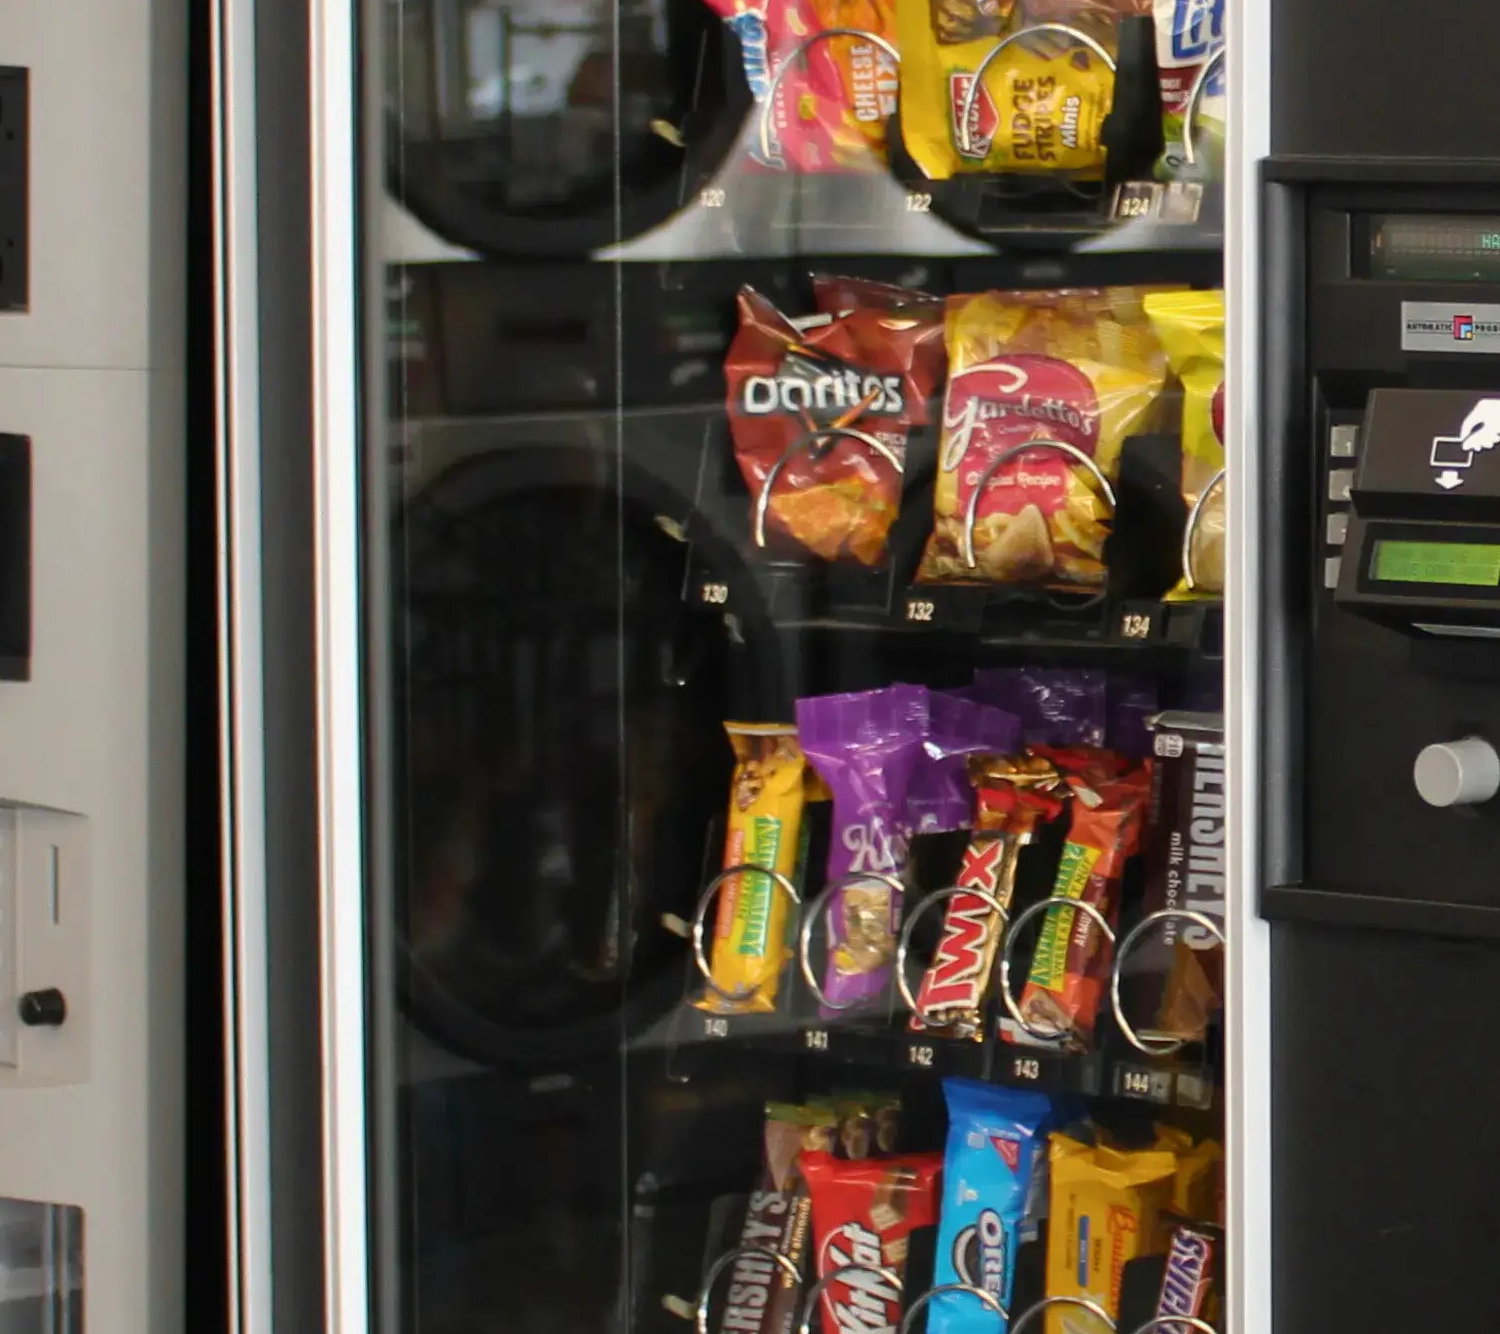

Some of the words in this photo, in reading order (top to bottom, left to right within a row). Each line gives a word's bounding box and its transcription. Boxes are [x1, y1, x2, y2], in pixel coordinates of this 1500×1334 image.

[850, 44, 878, 122] CHEESE
[1013, 78, 1035, 161] FUDGE
[1034, 75, 1056, 164] STRIPES
[1060, 95, 1081, 149] Minis
[906, 194, 932, 214] 122
[1122, 198, 1150, 218] 124
[744, 369, 903, 414] Doritos
[1017, 471, 1062, 489] Recipe
[702, 583, 727, 604] 130
[907, 601, 934, 622] 132
[1122, 614, 1150, 637] 134
[1168, 831, 1182, 865] milk
[704, 1018, 728, 1037] 140
[805, 1030, 829, 1051] 141
[909, 1046, 934, 1066] 142
[1015, 1058, 1040, 1080] 143
[1124, 1071, 1150, 1094] 144
[978, 1208, 1006, 1311] ORE
